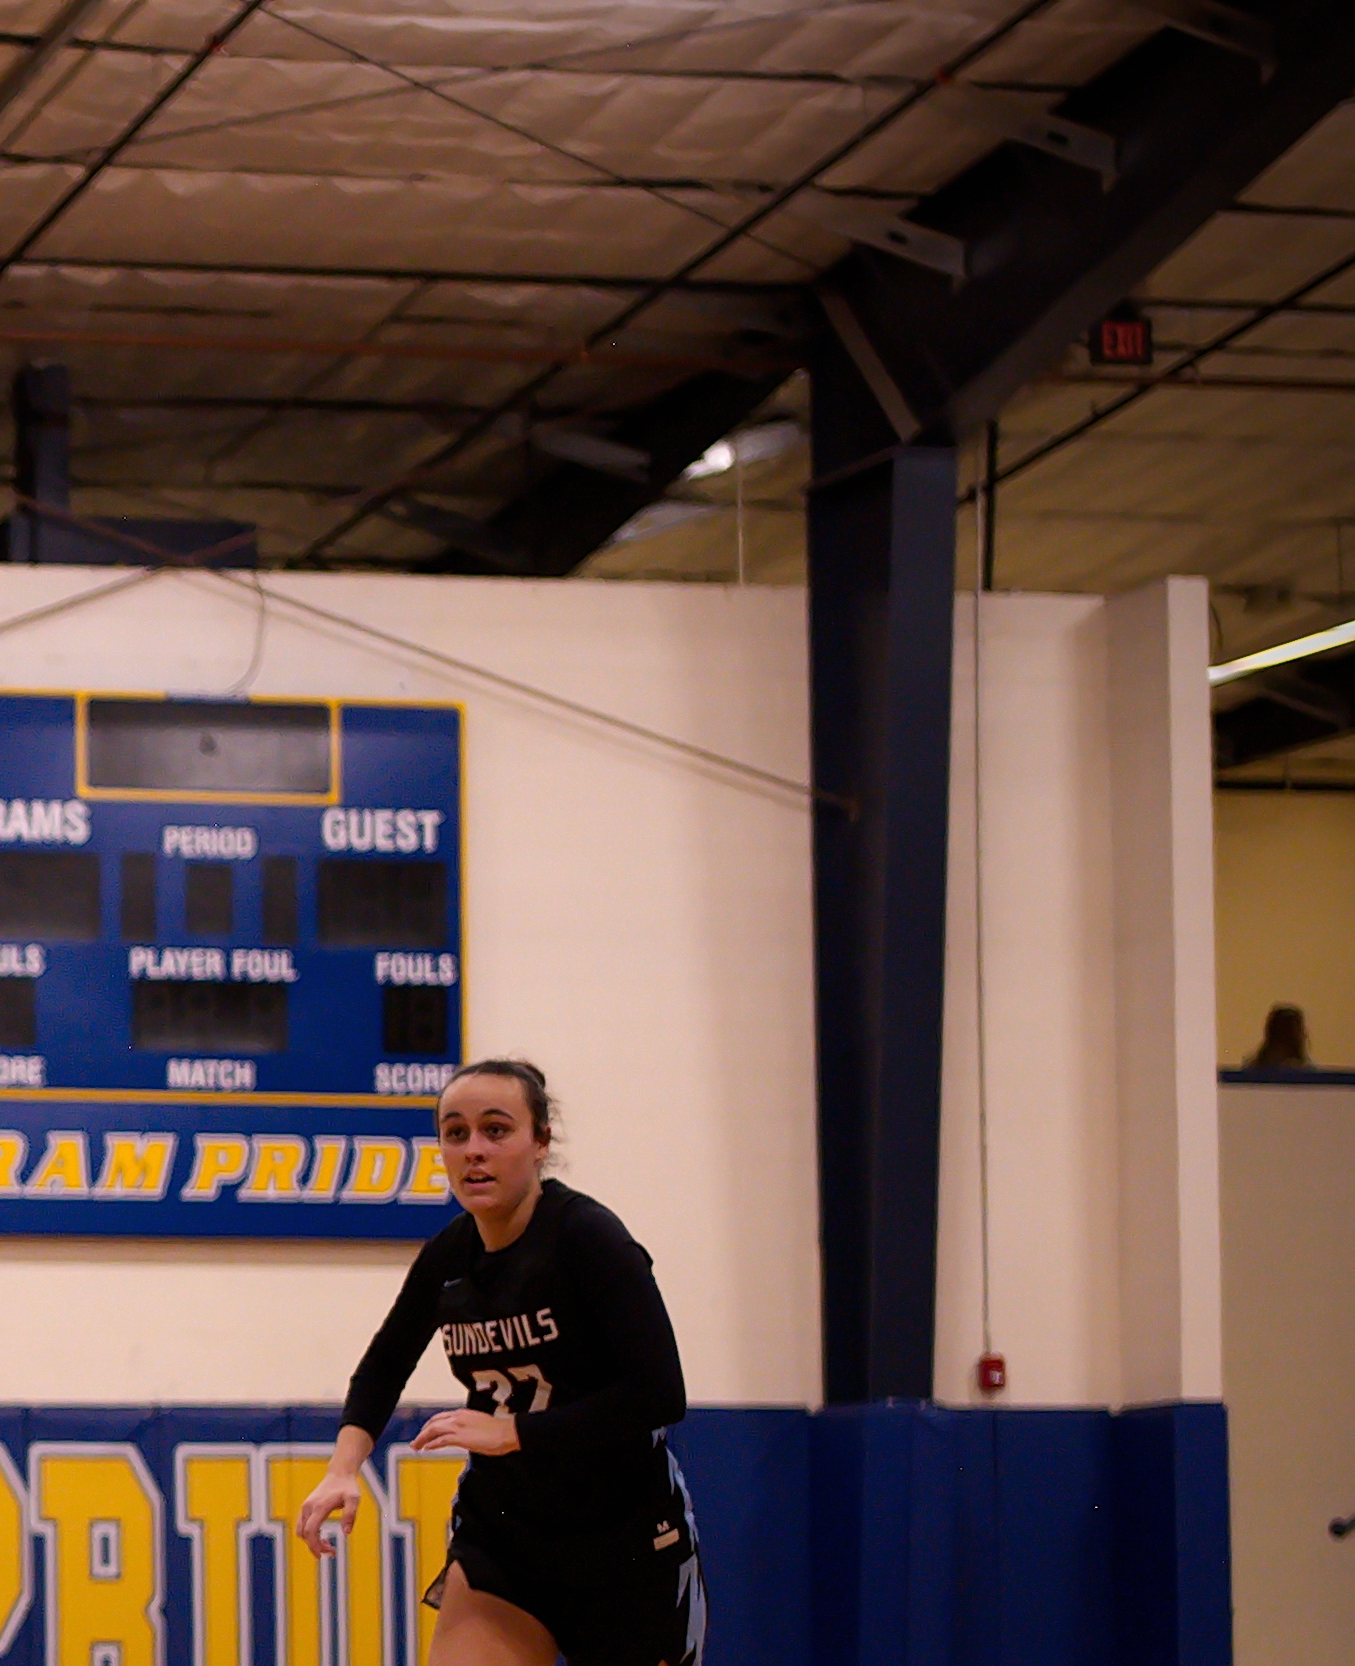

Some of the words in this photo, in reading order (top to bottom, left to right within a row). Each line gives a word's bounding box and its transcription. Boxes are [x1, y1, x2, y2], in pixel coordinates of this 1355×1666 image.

[162, 826, 258, 859] PERIOD
[321, 809, 444, 852] GUEST
[129, 947, 225, 981] PLAYER
[230, 950, 298, 983] FOUL
[375, 952, 458, 986] FOULS
[166, 1058, 257, 1092] MATCH
[181, 1132, 457, 1205] PRIDE
[442, 1306, 560, 1357] SUNDEVILS
